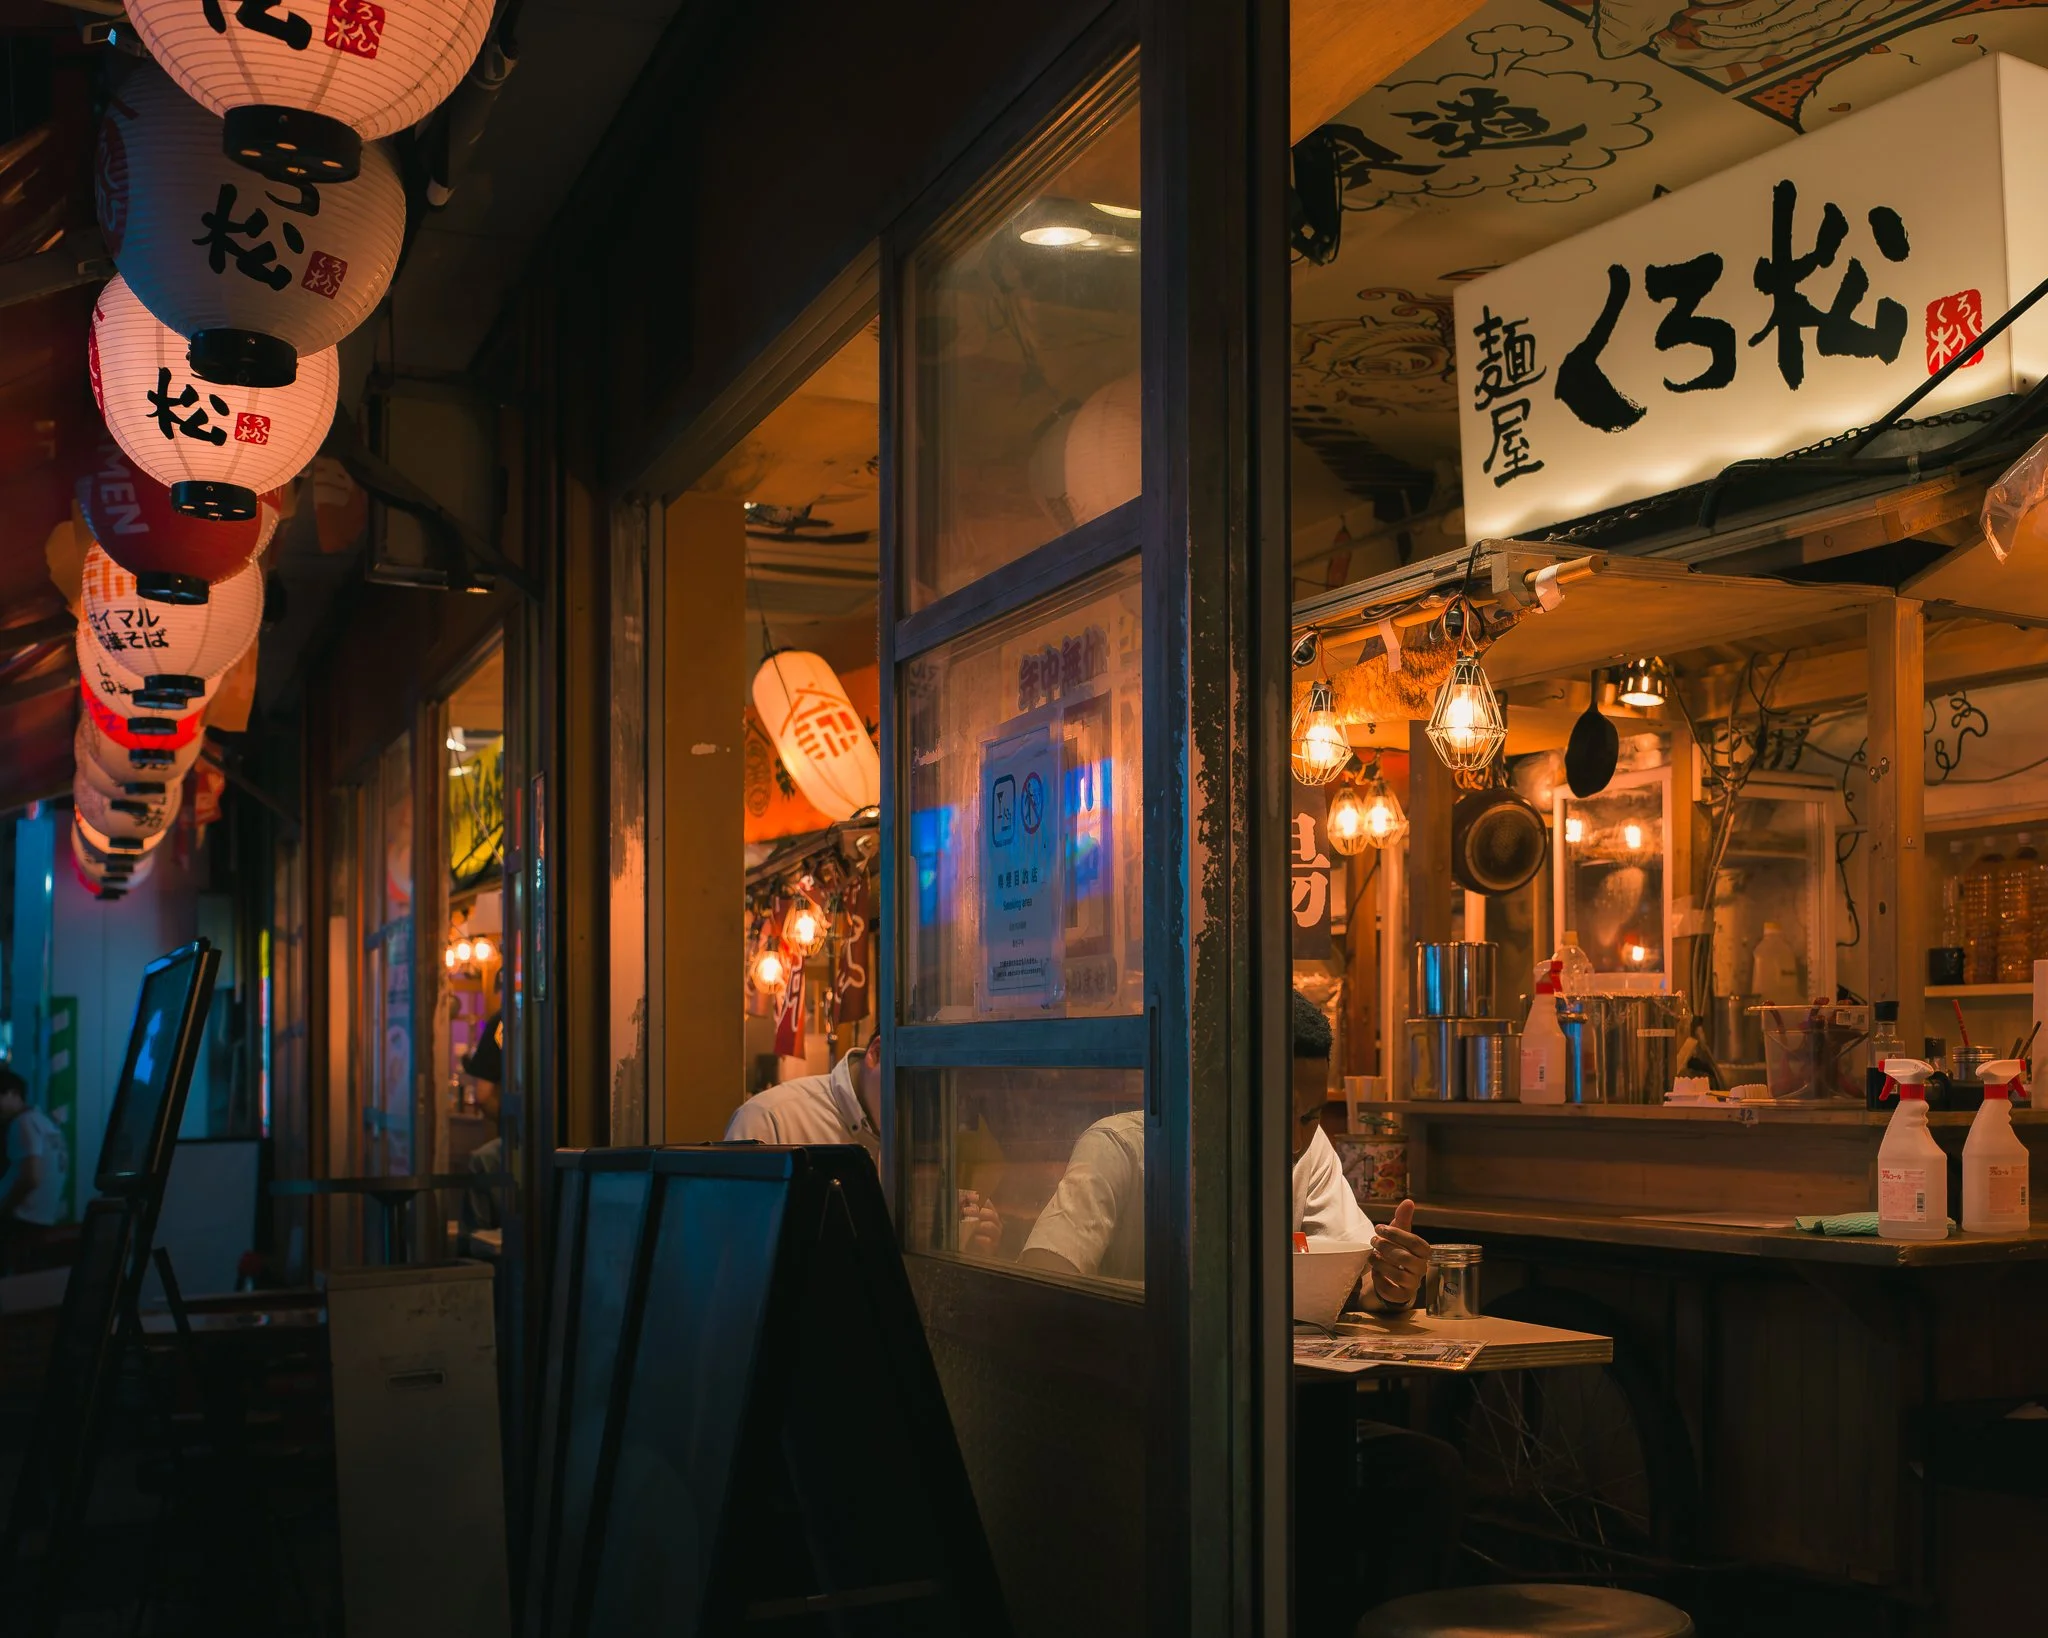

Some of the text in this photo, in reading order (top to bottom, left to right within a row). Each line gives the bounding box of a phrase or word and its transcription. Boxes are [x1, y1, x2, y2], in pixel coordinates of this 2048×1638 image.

[1555, 179, 1911, 434] くろ松
[146, 367, 231, 447] 松
[1473, 305, 1546, 488] 麺屋
[1022, 897, 1033, 908] area
